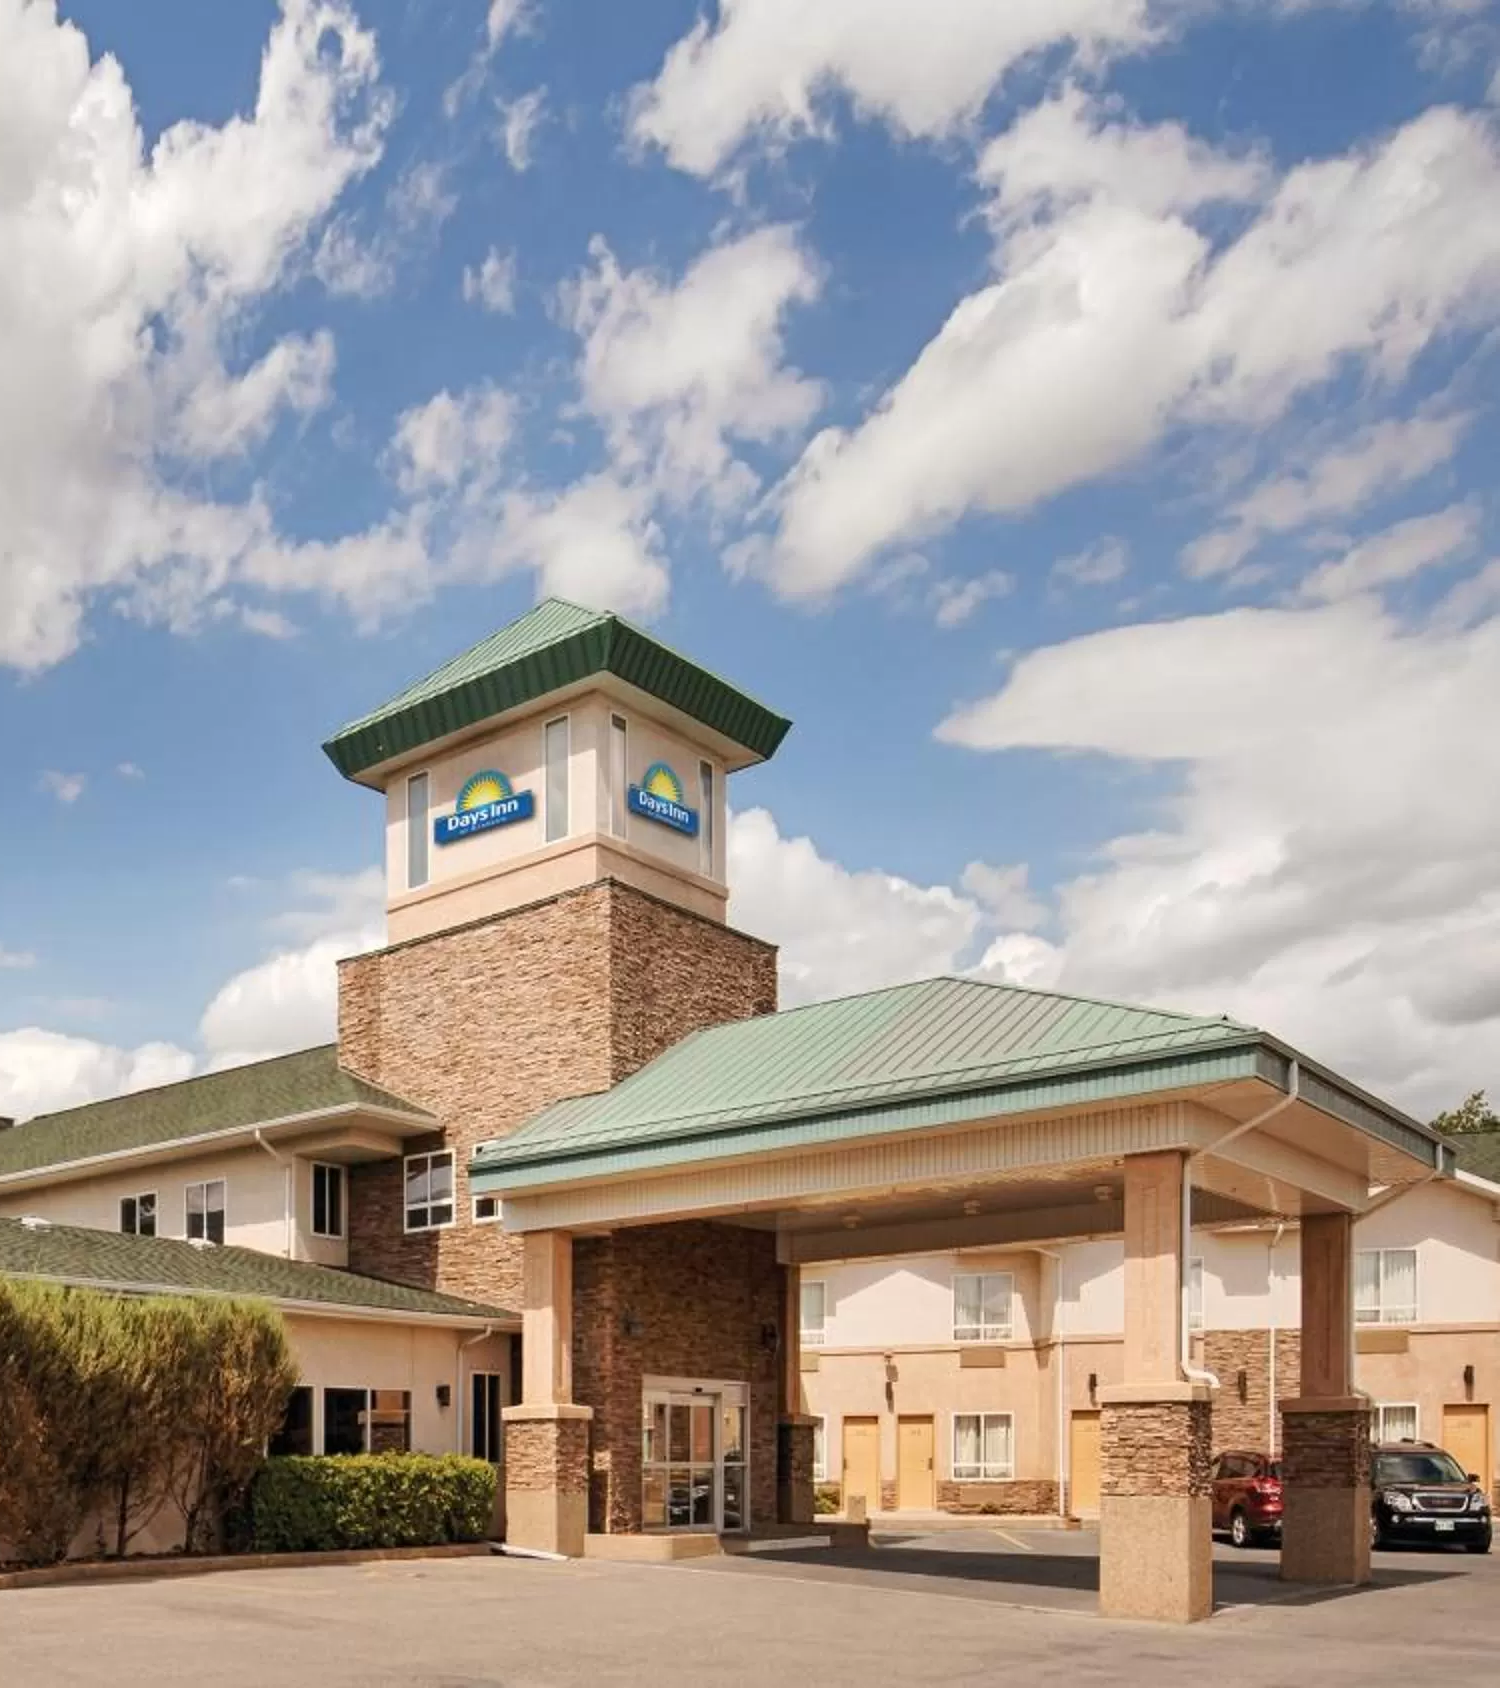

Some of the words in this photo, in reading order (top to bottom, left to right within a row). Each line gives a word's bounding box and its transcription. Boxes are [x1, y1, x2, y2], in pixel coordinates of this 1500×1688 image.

[447, 809, 488, 831] Days
[491, 800, 518, 817] Inn
[639, 791, 668, 814] Days
[669, 803, 689, 824] Inn
